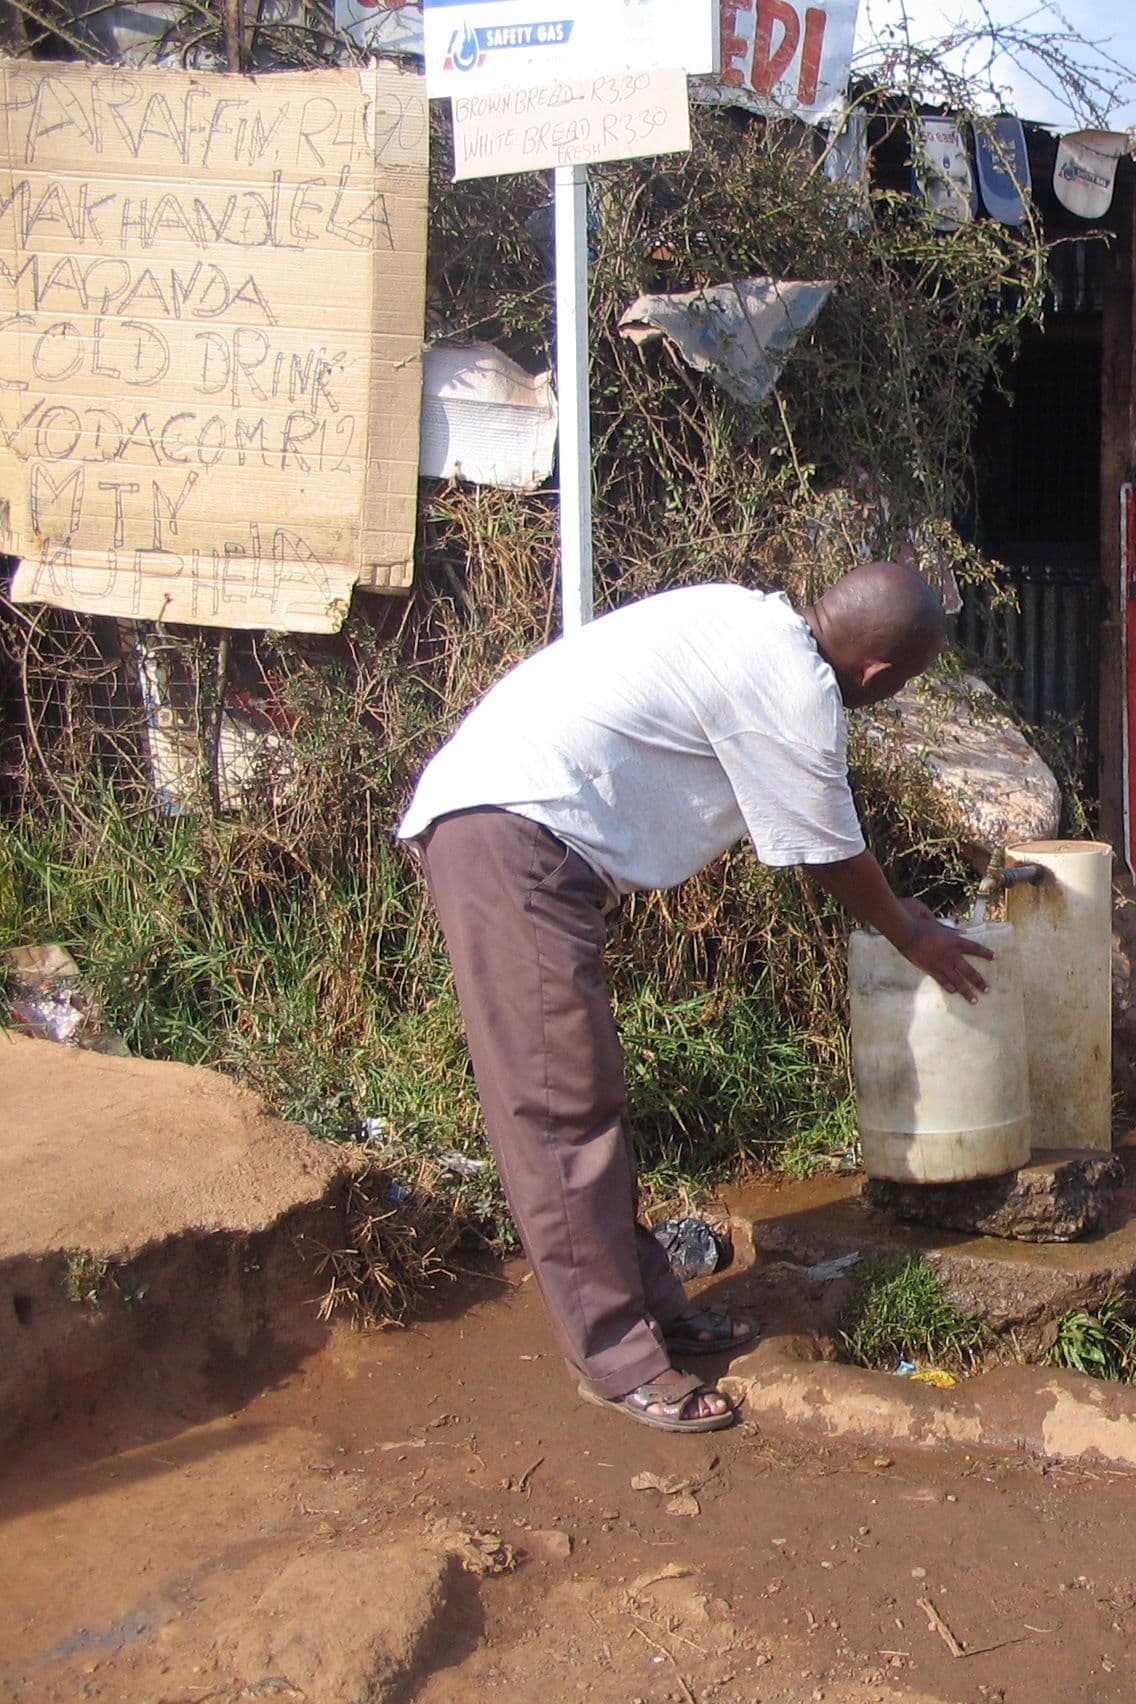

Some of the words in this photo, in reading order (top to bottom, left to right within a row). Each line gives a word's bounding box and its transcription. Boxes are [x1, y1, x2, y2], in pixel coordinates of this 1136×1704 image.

[486, 26, 533, 47] SAFETY
[537, 24, 564, 43] GAS
[455, 93, 511, 123] BROWN
[514, 82, 577, 114] BREAD
[463, 128, 514, 161] WHITE
[522, 118, 591, 155] BREAD
[193, 327, 348, 415] DRINK
